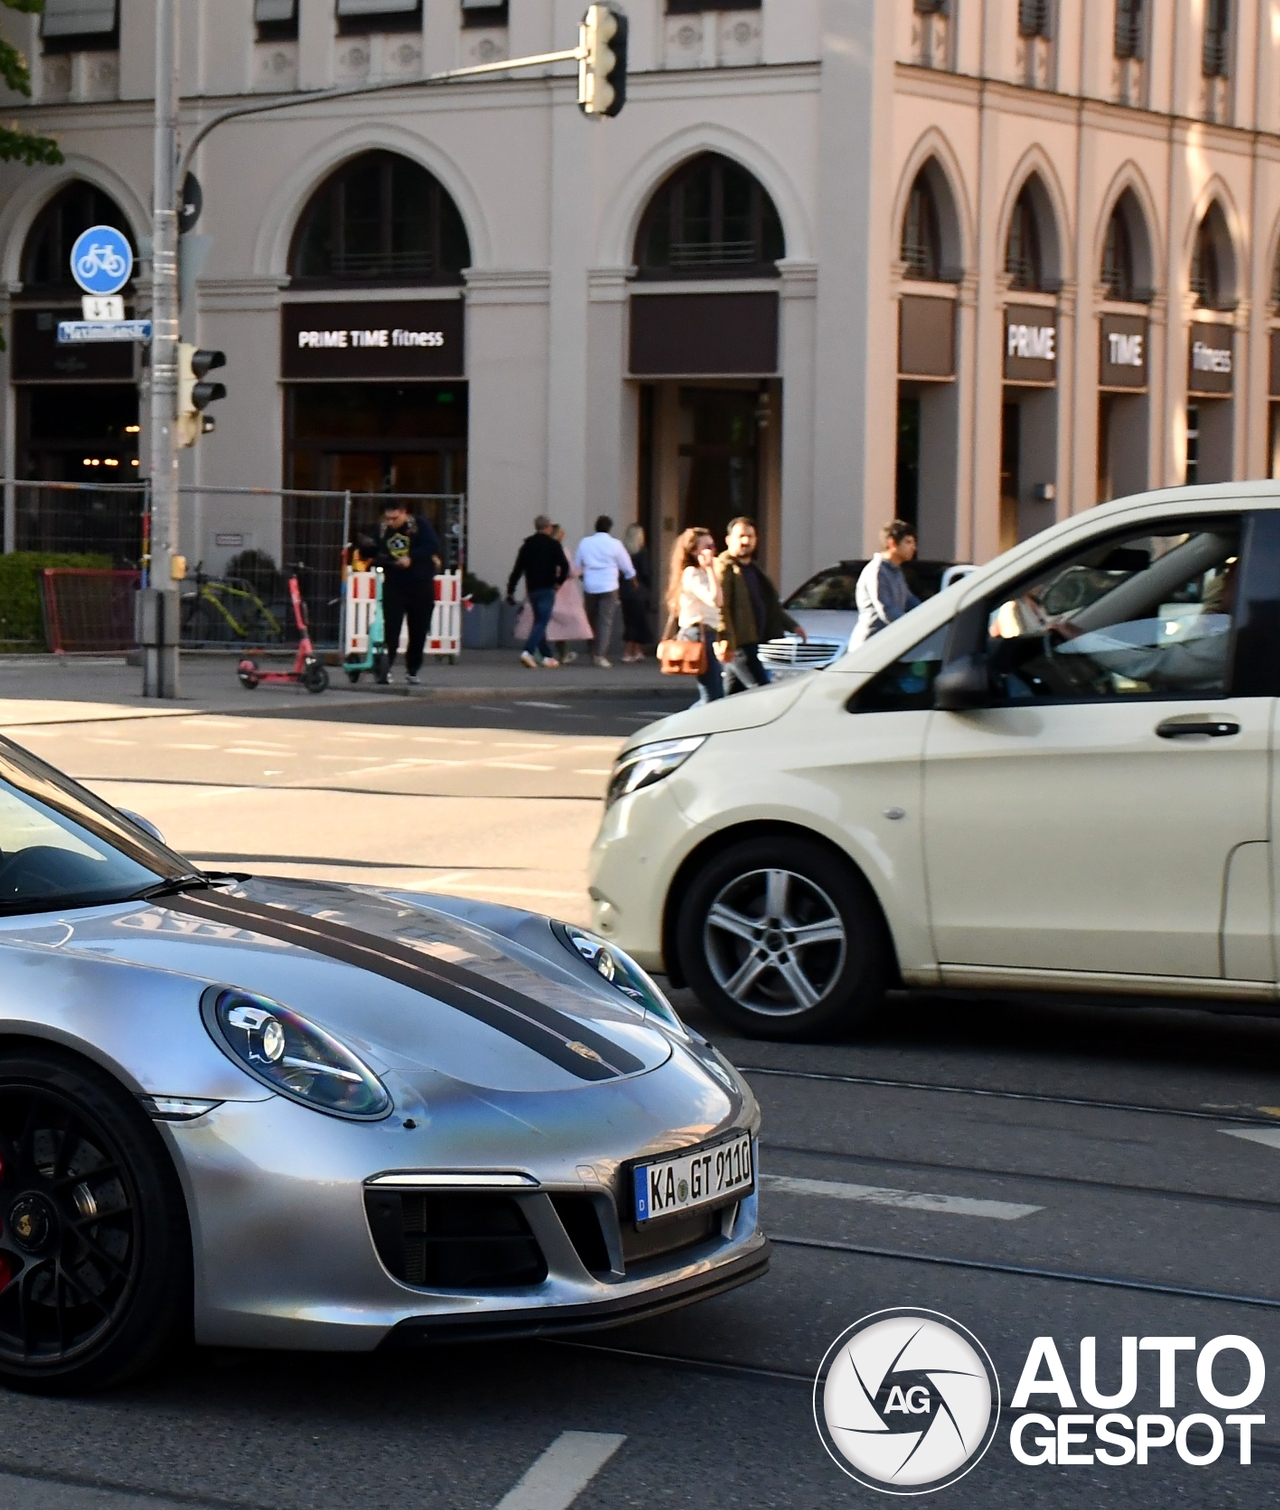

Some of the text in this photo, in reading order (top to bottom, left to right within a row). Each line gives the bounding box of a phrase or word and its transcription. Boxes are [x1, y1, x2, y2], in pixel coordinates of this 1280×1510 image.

[298, 329, 444, 348] PRIME TIME fitness
[1008, 324, 1055, 360] PRIME
[1108, 332, 1143, 366] TIME
[650, 1140, 750, 1211] KA GT 9110
[639, 1199, 646, 1212] D
